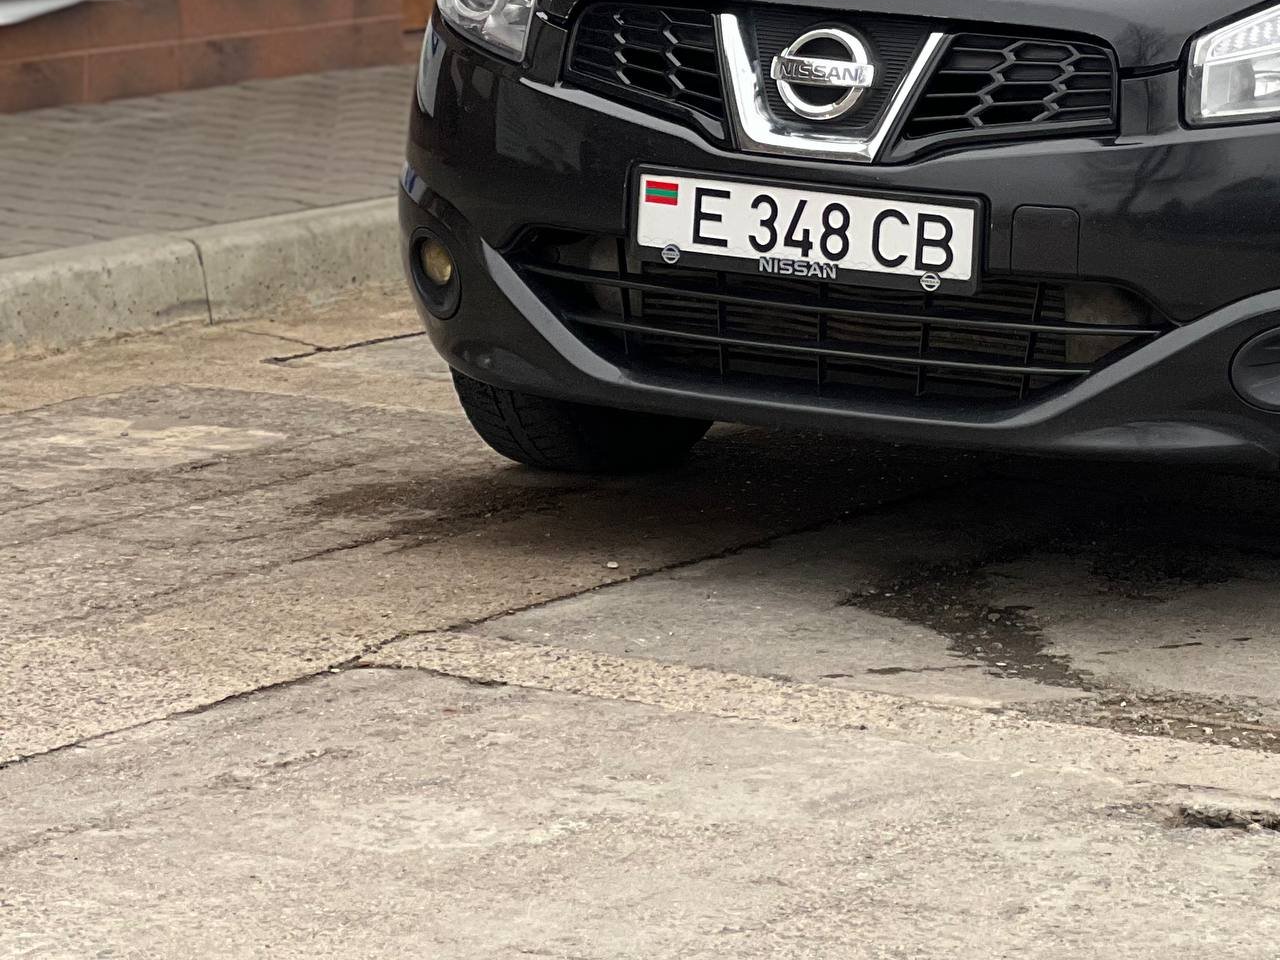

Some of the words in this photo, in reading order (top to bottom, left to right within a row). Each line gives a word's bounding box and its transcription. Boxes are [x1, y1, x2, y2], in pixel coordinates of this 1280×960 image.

[780, 60, 860, 83] NISSAN
[692, 186, 731, 248] E
[748, 194, 850, 262] 348
[872, 208, 954, 273] CB
[758, 256, 839, 280] NISSAN
